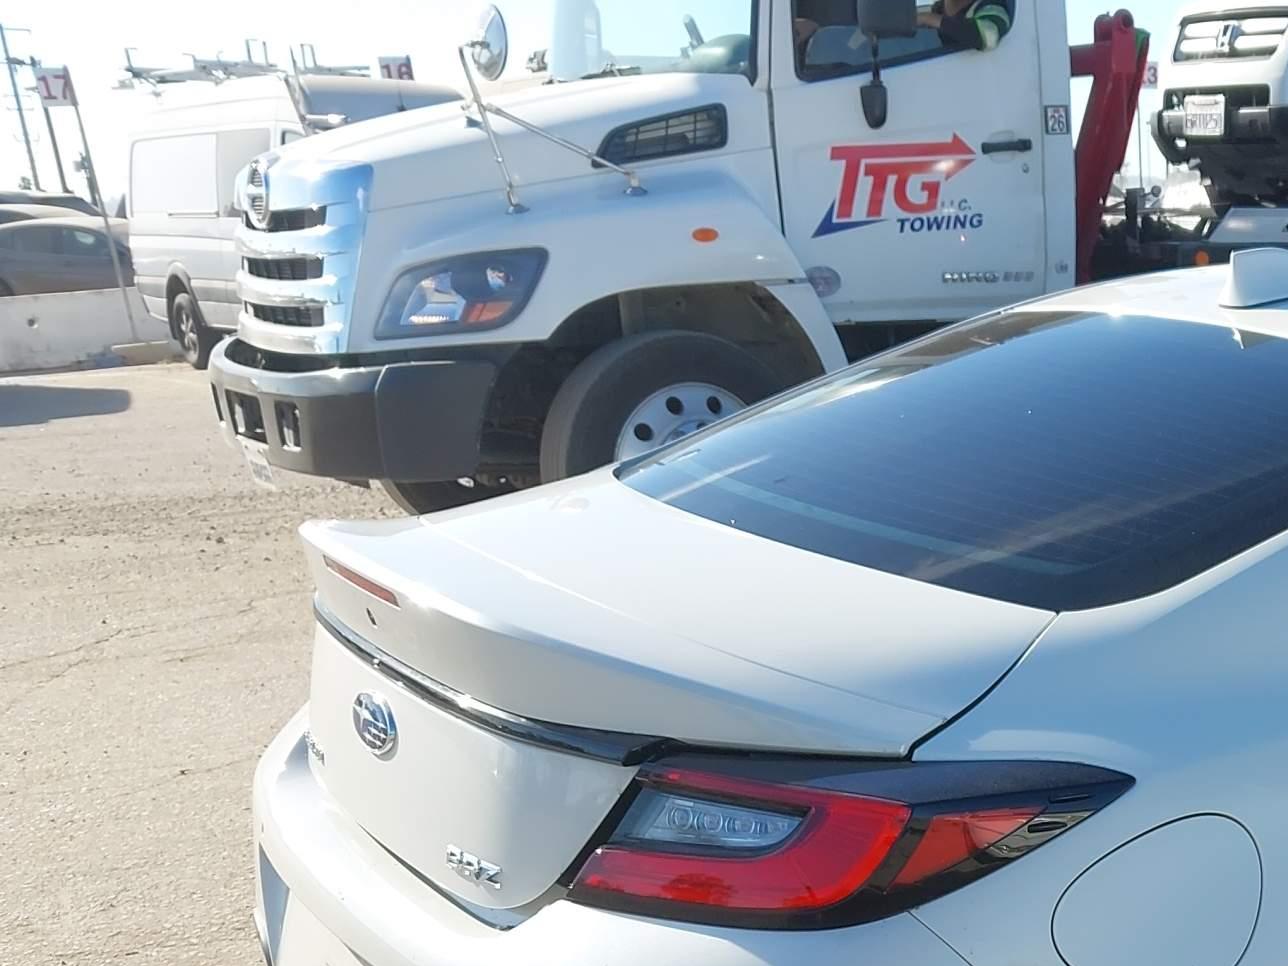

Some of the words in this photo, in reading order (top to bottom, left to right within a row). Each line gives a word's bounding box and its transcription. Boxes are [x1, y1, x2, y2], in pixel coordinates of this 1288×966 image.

[1050, 114, 1065, 132] 26
[829, 143, 944, 219] TTG
[896, 213, 983, 234] TOWING
[446, 846, 502, 889] BRZ
